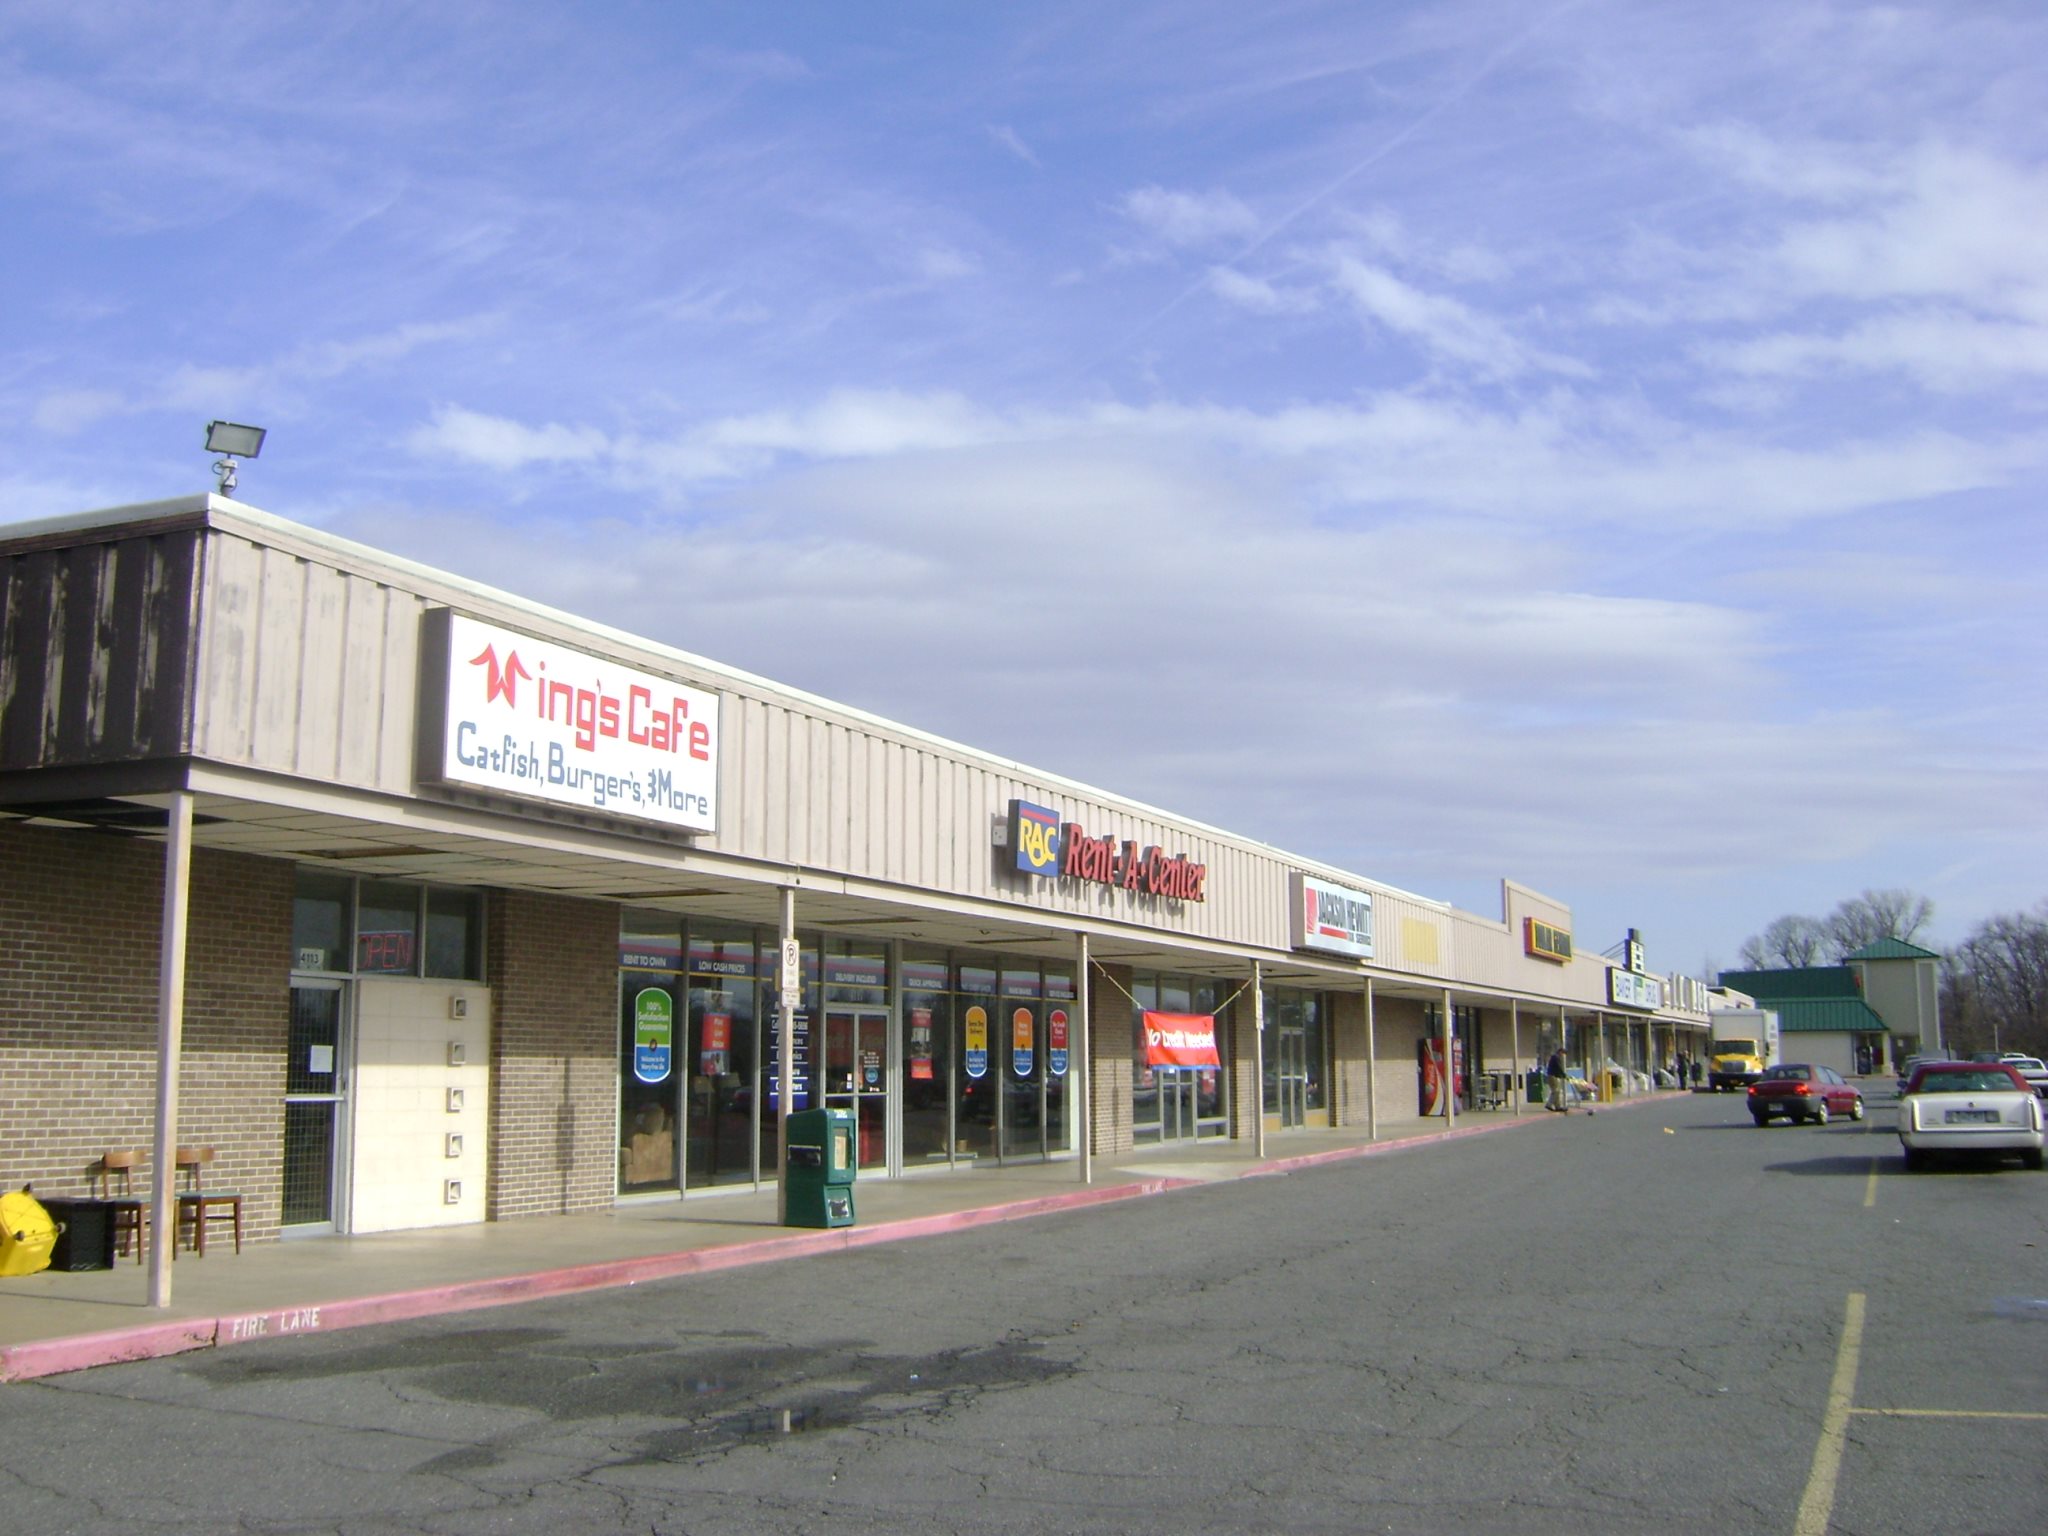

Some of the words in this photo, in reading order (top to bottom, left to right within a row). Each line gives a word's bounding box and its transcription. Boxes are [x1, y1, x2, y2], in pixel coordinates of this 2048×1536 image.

[469, 643, 619, 752] Wing's
[628, 684, 709, 761] Cafe
[457, 720, 545, 788] Catfish,
[1019, 816, 1057, 868] RAC
[301, 952, 319, 964] 4113
[650, 957, 666, 967] OWN
[1148, 1028, 1160, 1047] No
[233, 1316, 269, 1339] FIRE
[280, 1307, 321, 1332] LANE
